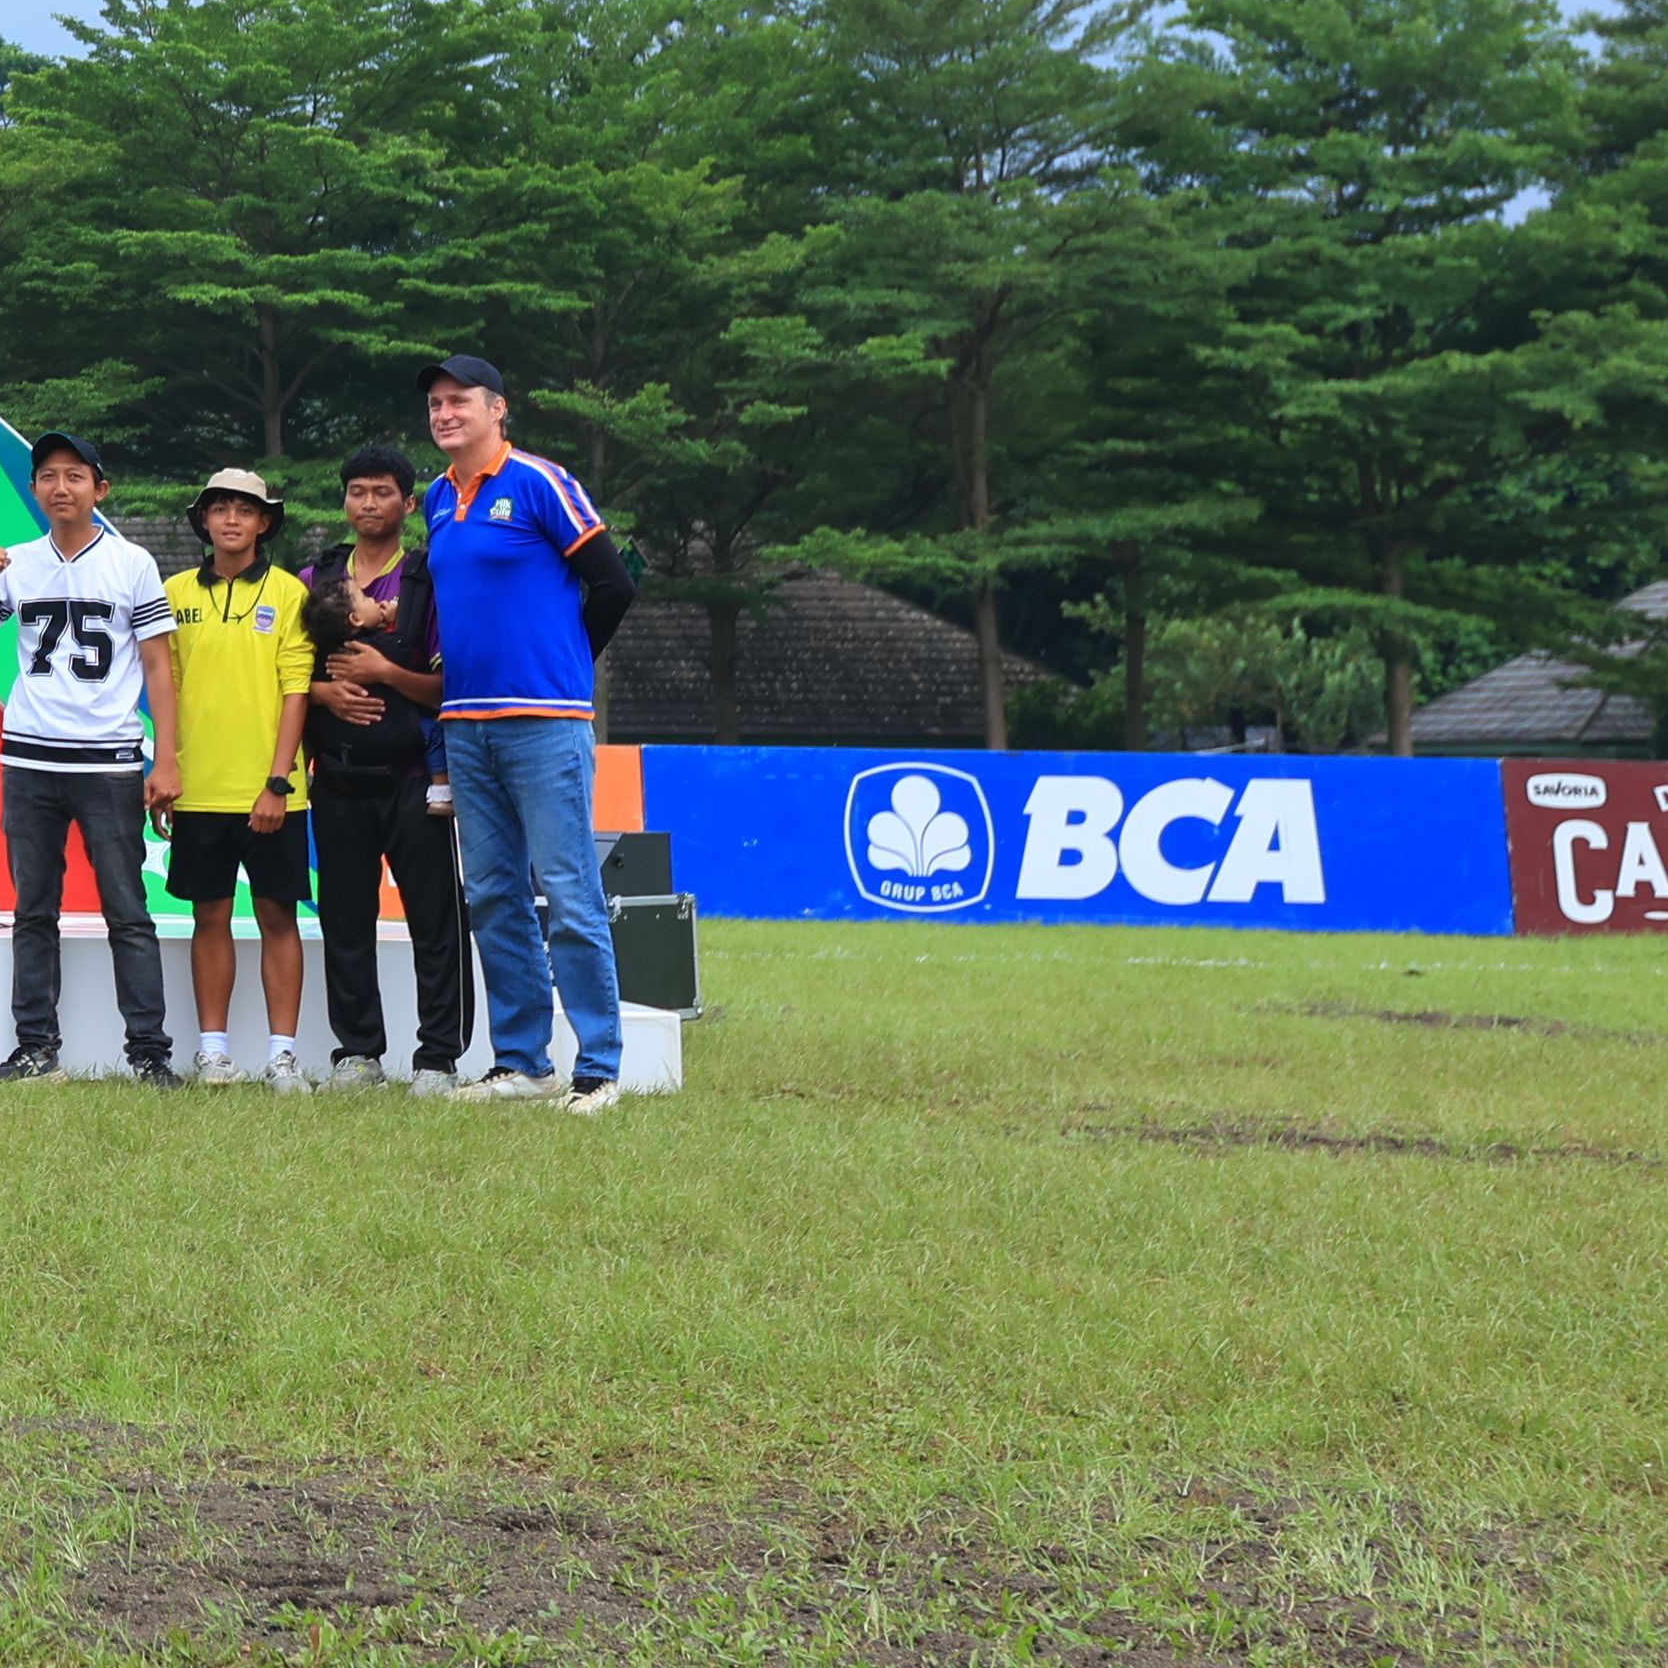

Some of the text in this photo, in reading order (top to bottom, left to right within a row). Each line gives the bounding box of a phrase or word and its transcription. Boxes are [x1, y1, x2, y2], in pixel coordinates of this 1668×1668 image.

[18, 597, 115, 683] 75
[1532, 780, 1600, 798] SAVORIA
[1014, 774, 1326, 906] BCA
[879, 878, 964, 902] GRUP BCA
